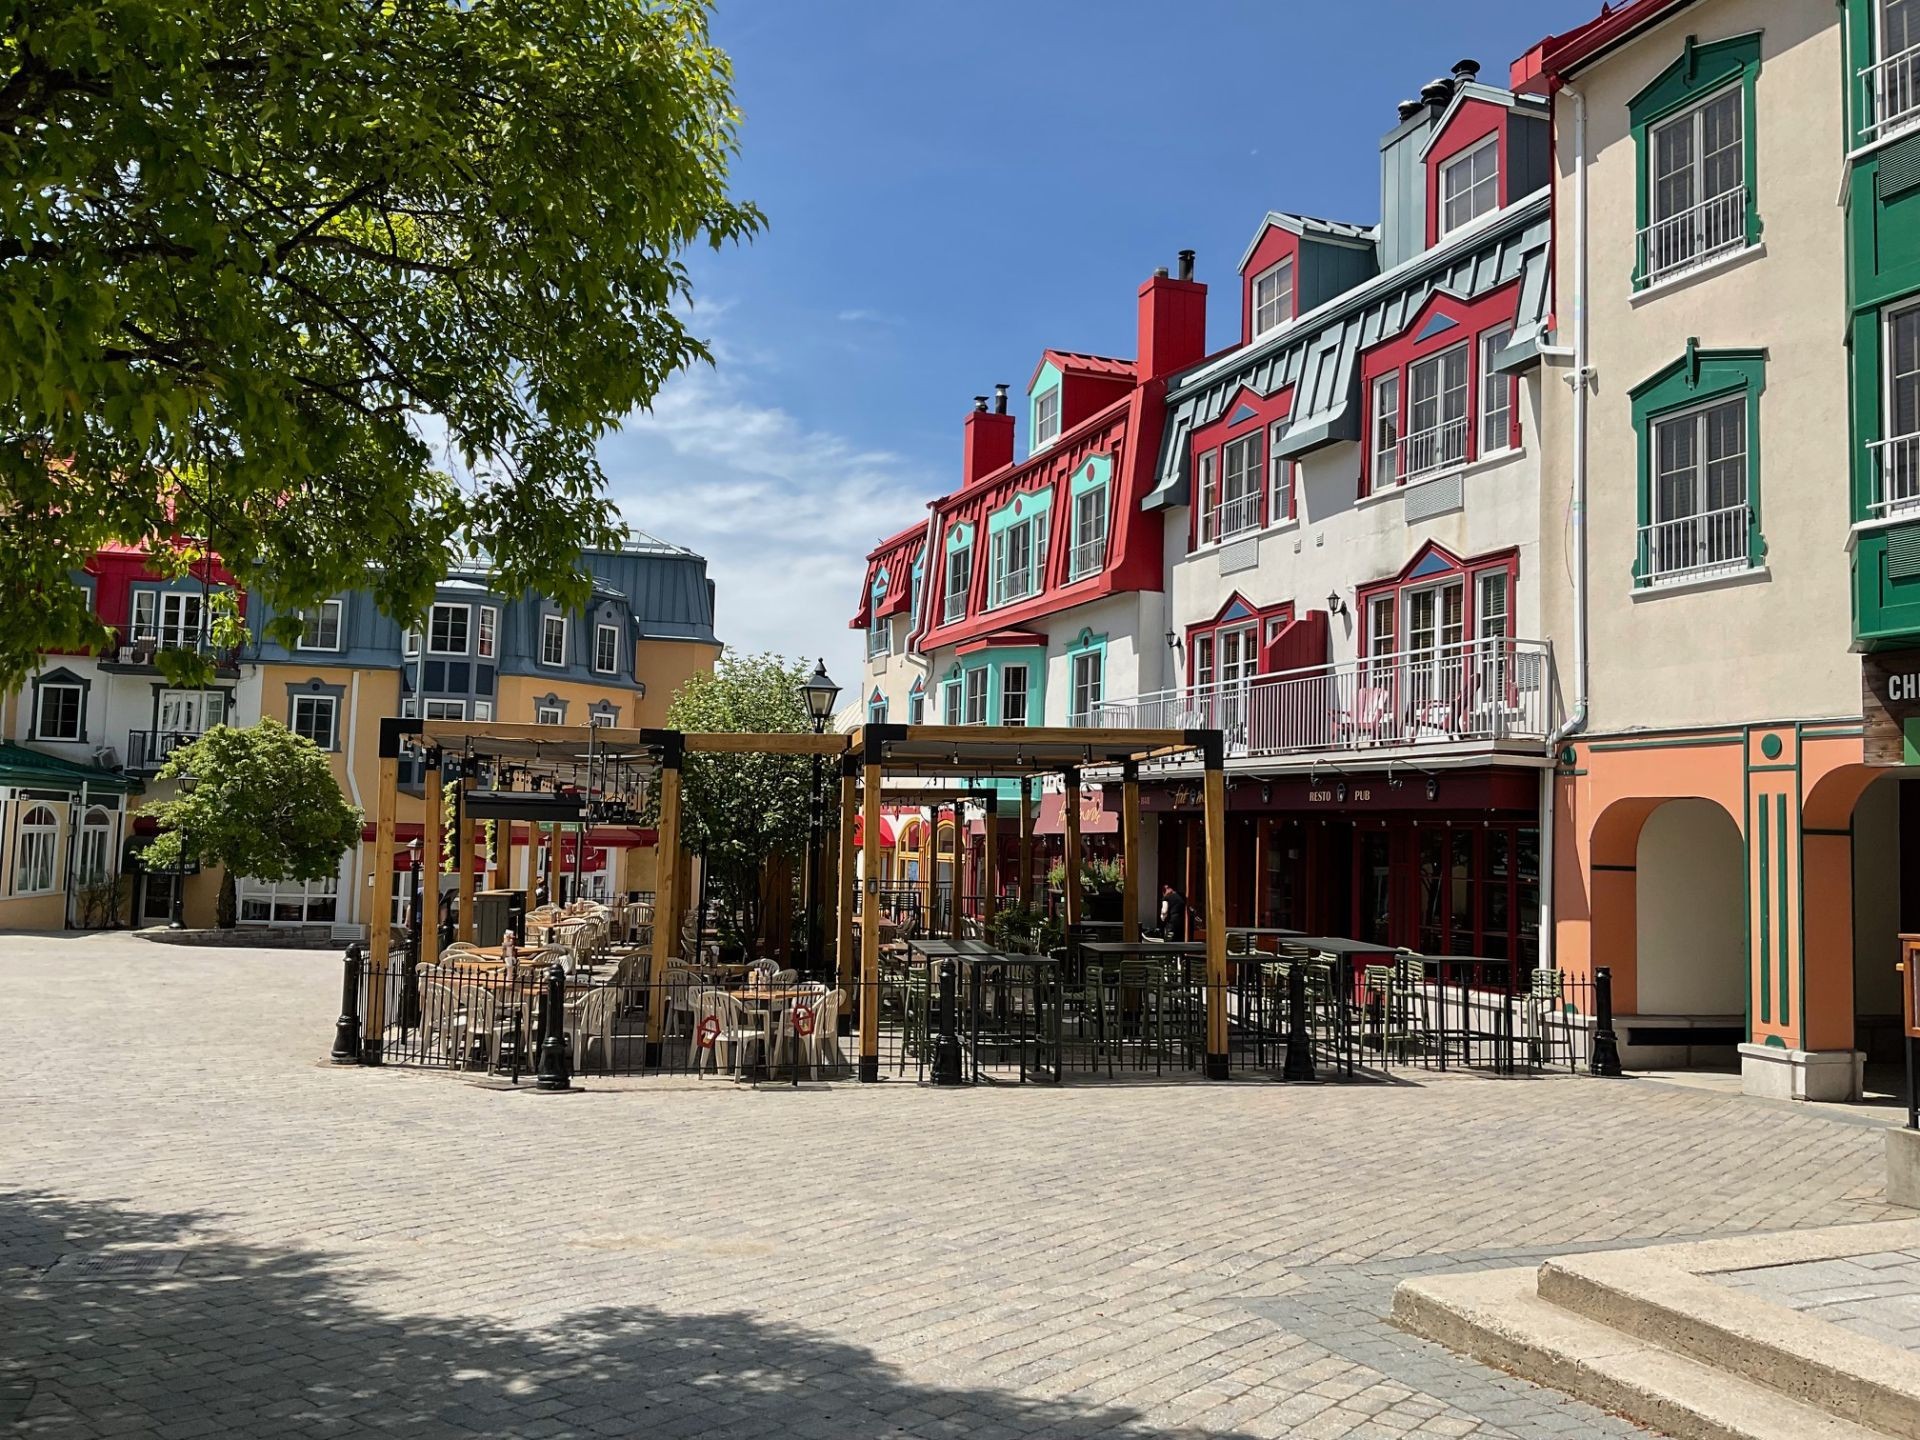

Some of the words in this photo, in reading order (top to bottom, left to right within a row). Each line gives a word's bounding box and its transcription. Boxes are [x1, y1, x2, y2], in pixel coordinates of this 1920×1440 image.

[1888, 673, 1920, 701] CH
[1309, 791, 1331, 801] RESTO
[1354, 790, 1370, 800] PUB
